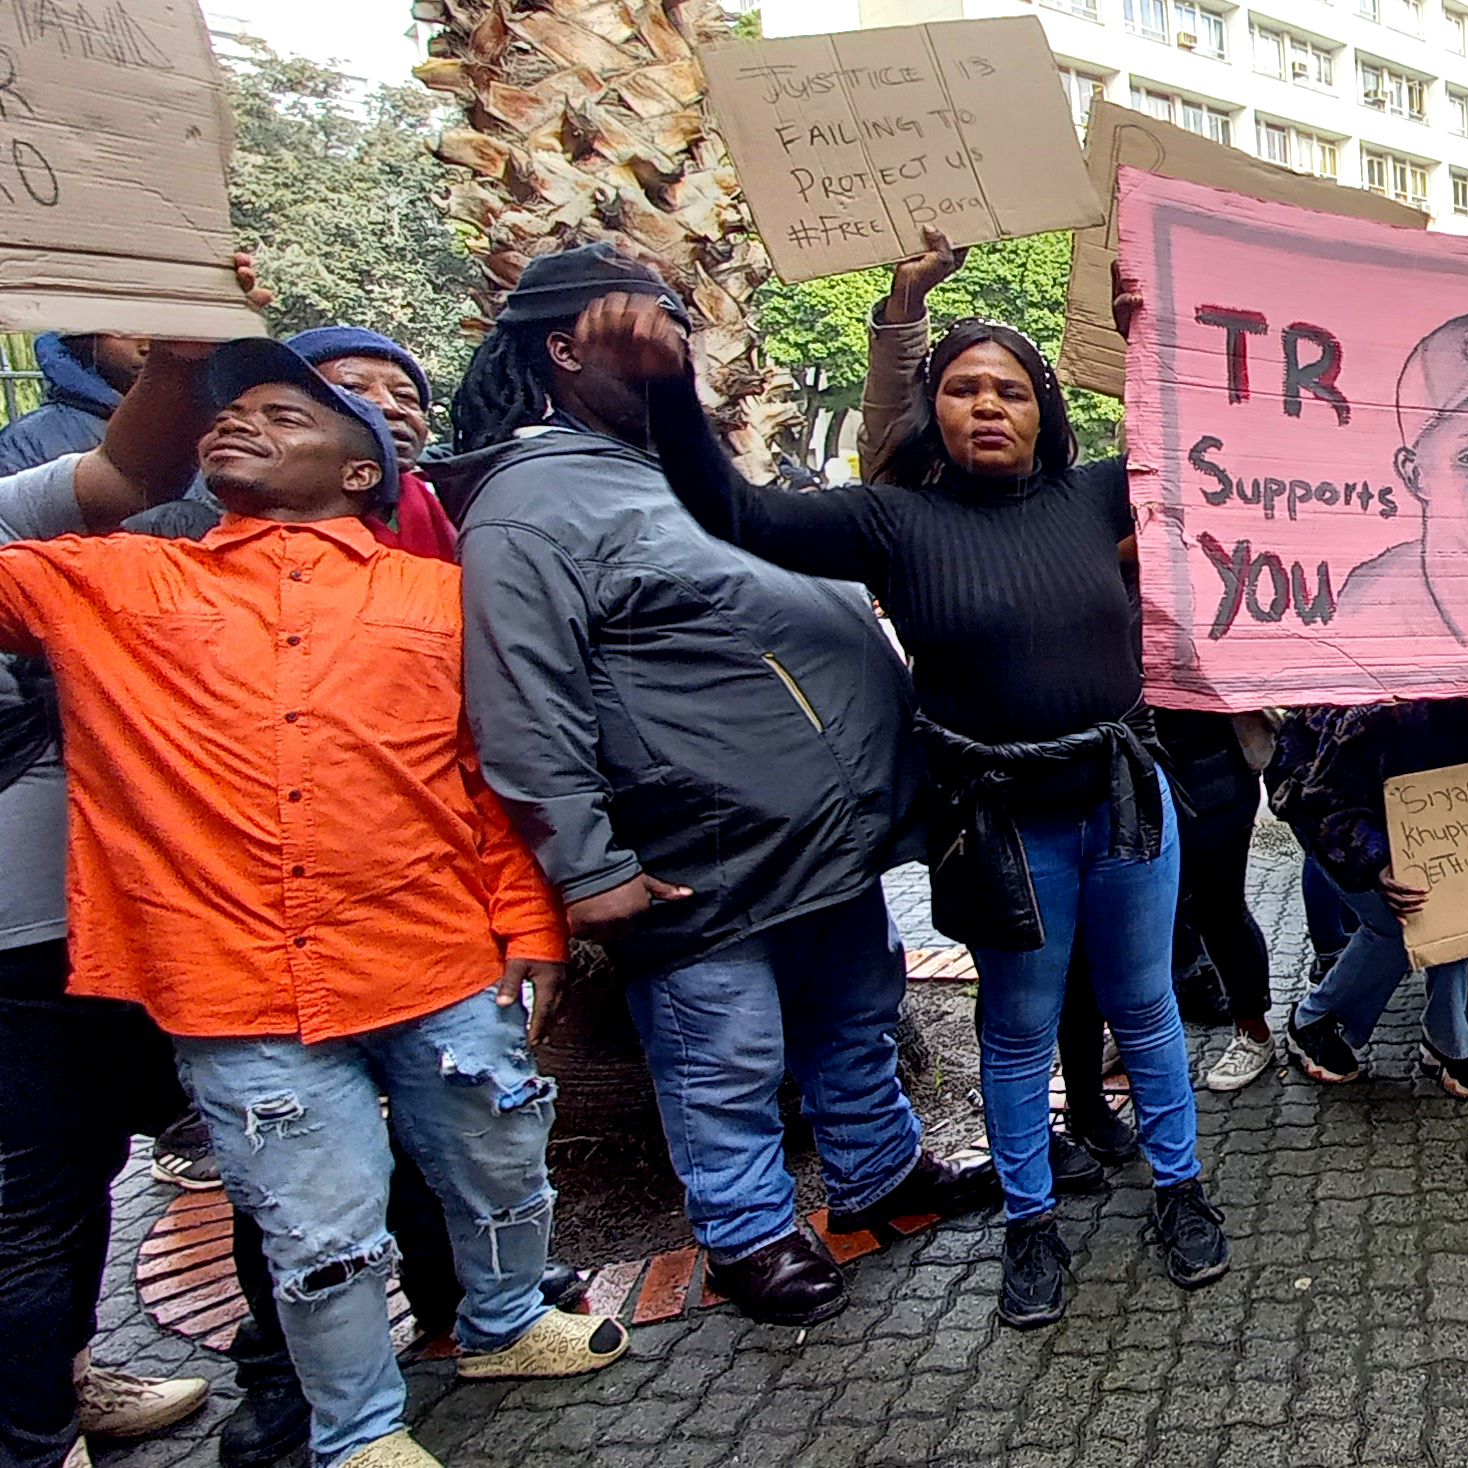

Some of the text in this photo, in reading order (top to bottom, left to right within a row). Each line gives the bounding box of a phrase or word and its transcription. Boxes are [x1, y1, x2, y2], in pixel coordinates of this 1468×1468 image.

[774, 108, 976, 154] FAILING TO
[790, 154, 928, 203] PROTECT
[1194, 304, 1351, 427] TR
[1188, 435, 1398, 521] Supports
